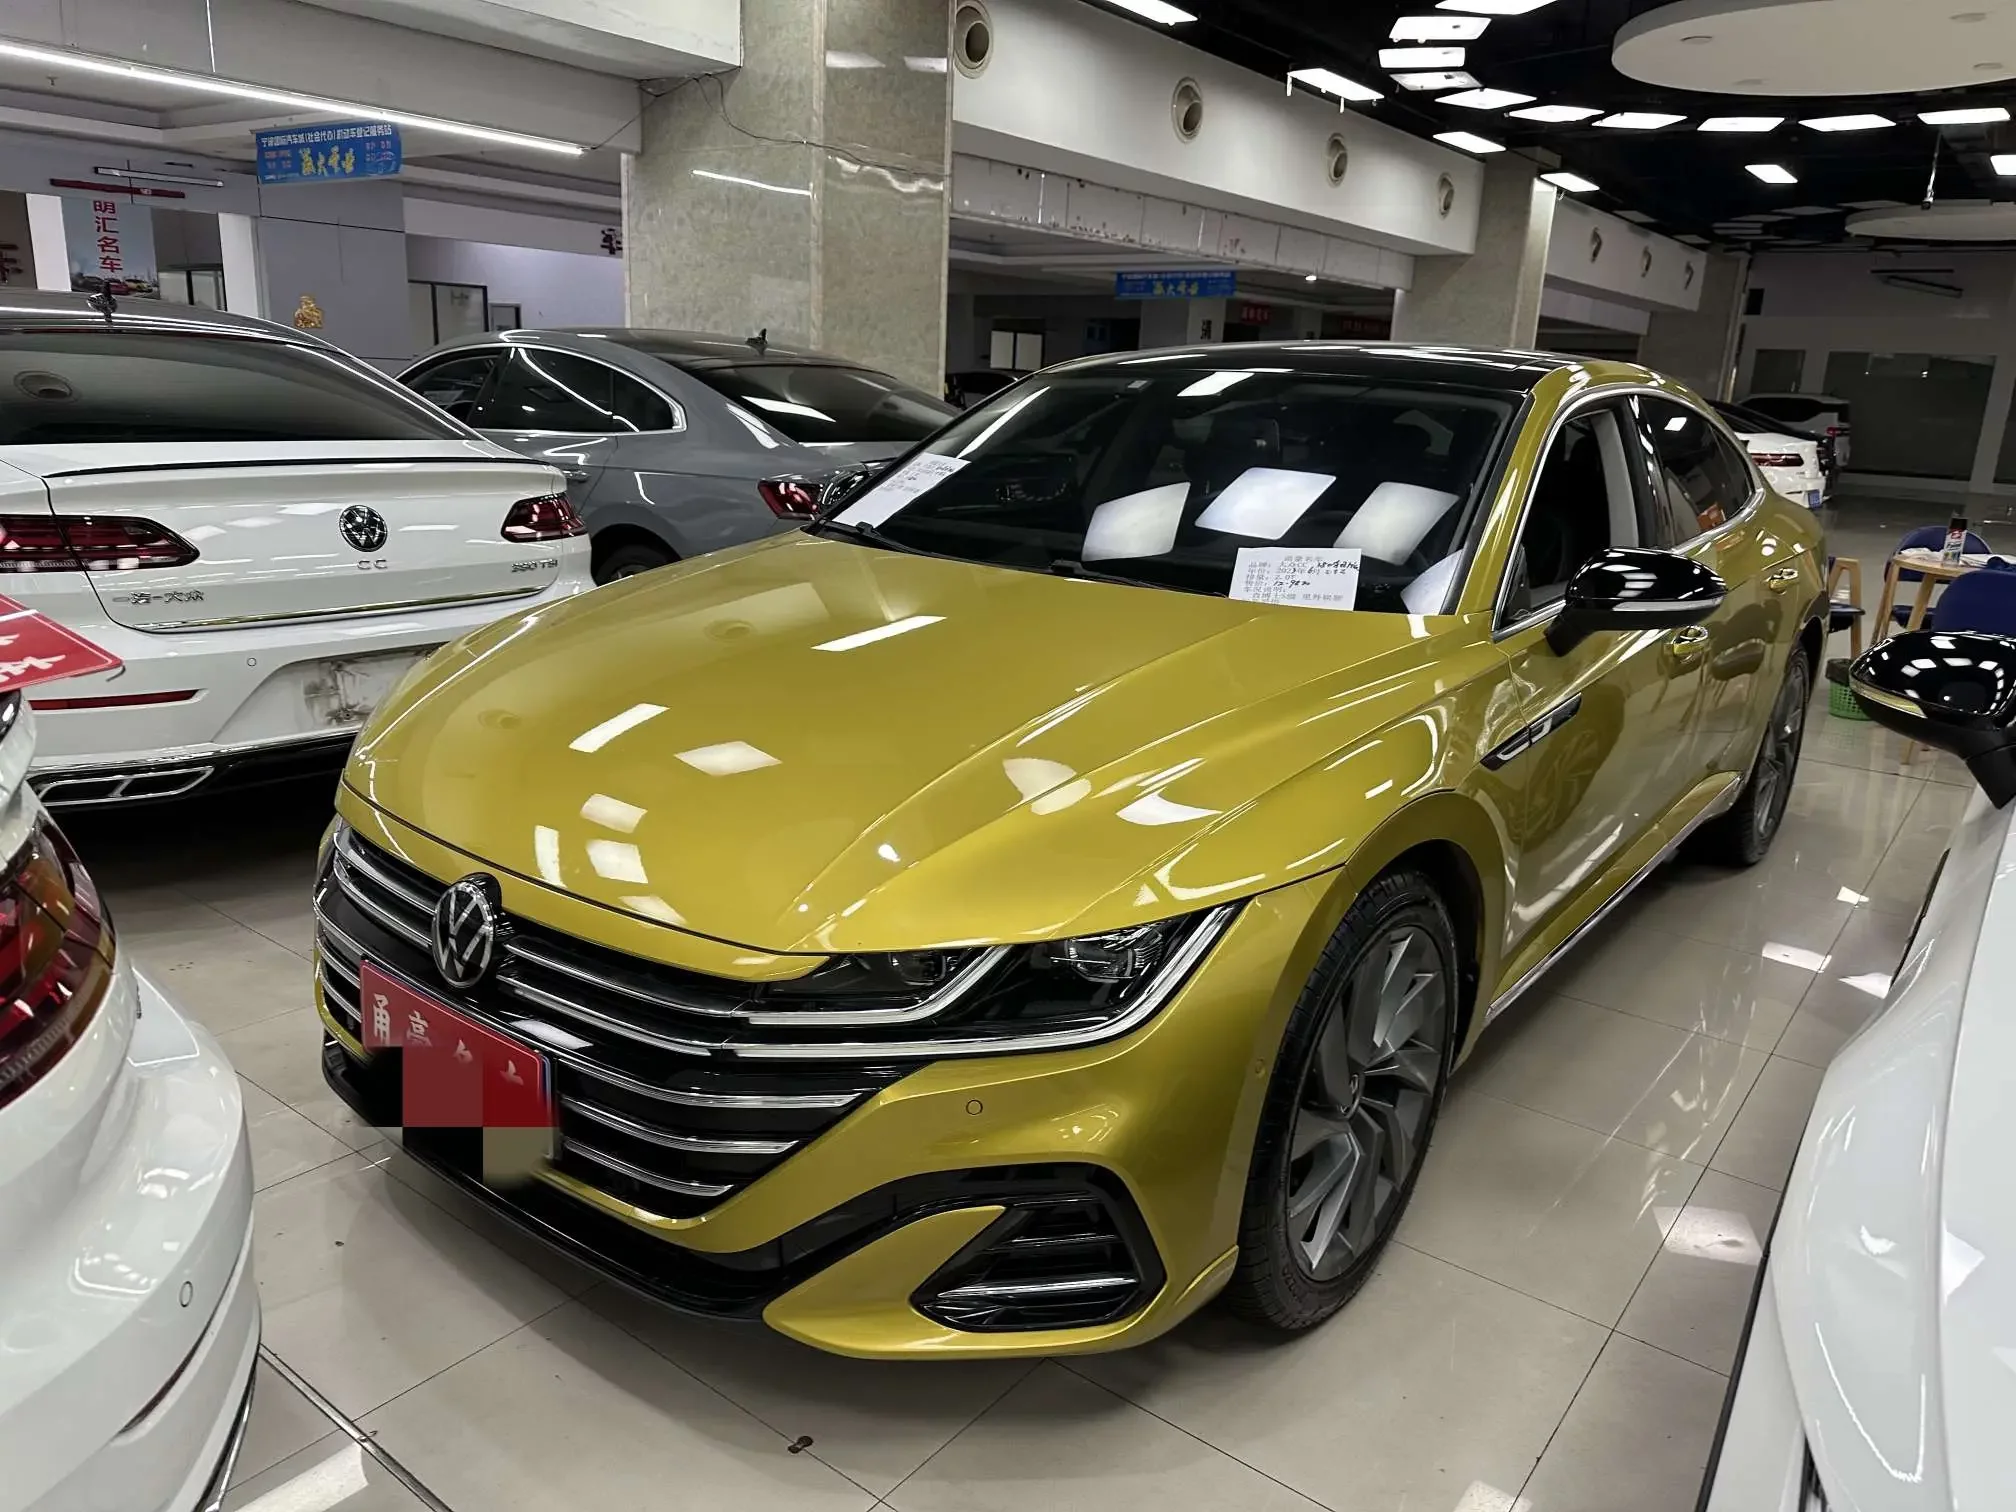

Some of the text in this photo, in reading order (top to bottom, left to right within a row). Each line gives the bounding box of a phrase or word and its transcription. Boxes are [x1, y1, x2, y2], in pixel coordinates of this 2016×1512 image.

[93, 199, 123, 273] 明汇名车
[357, 559, 387, 570] CC
